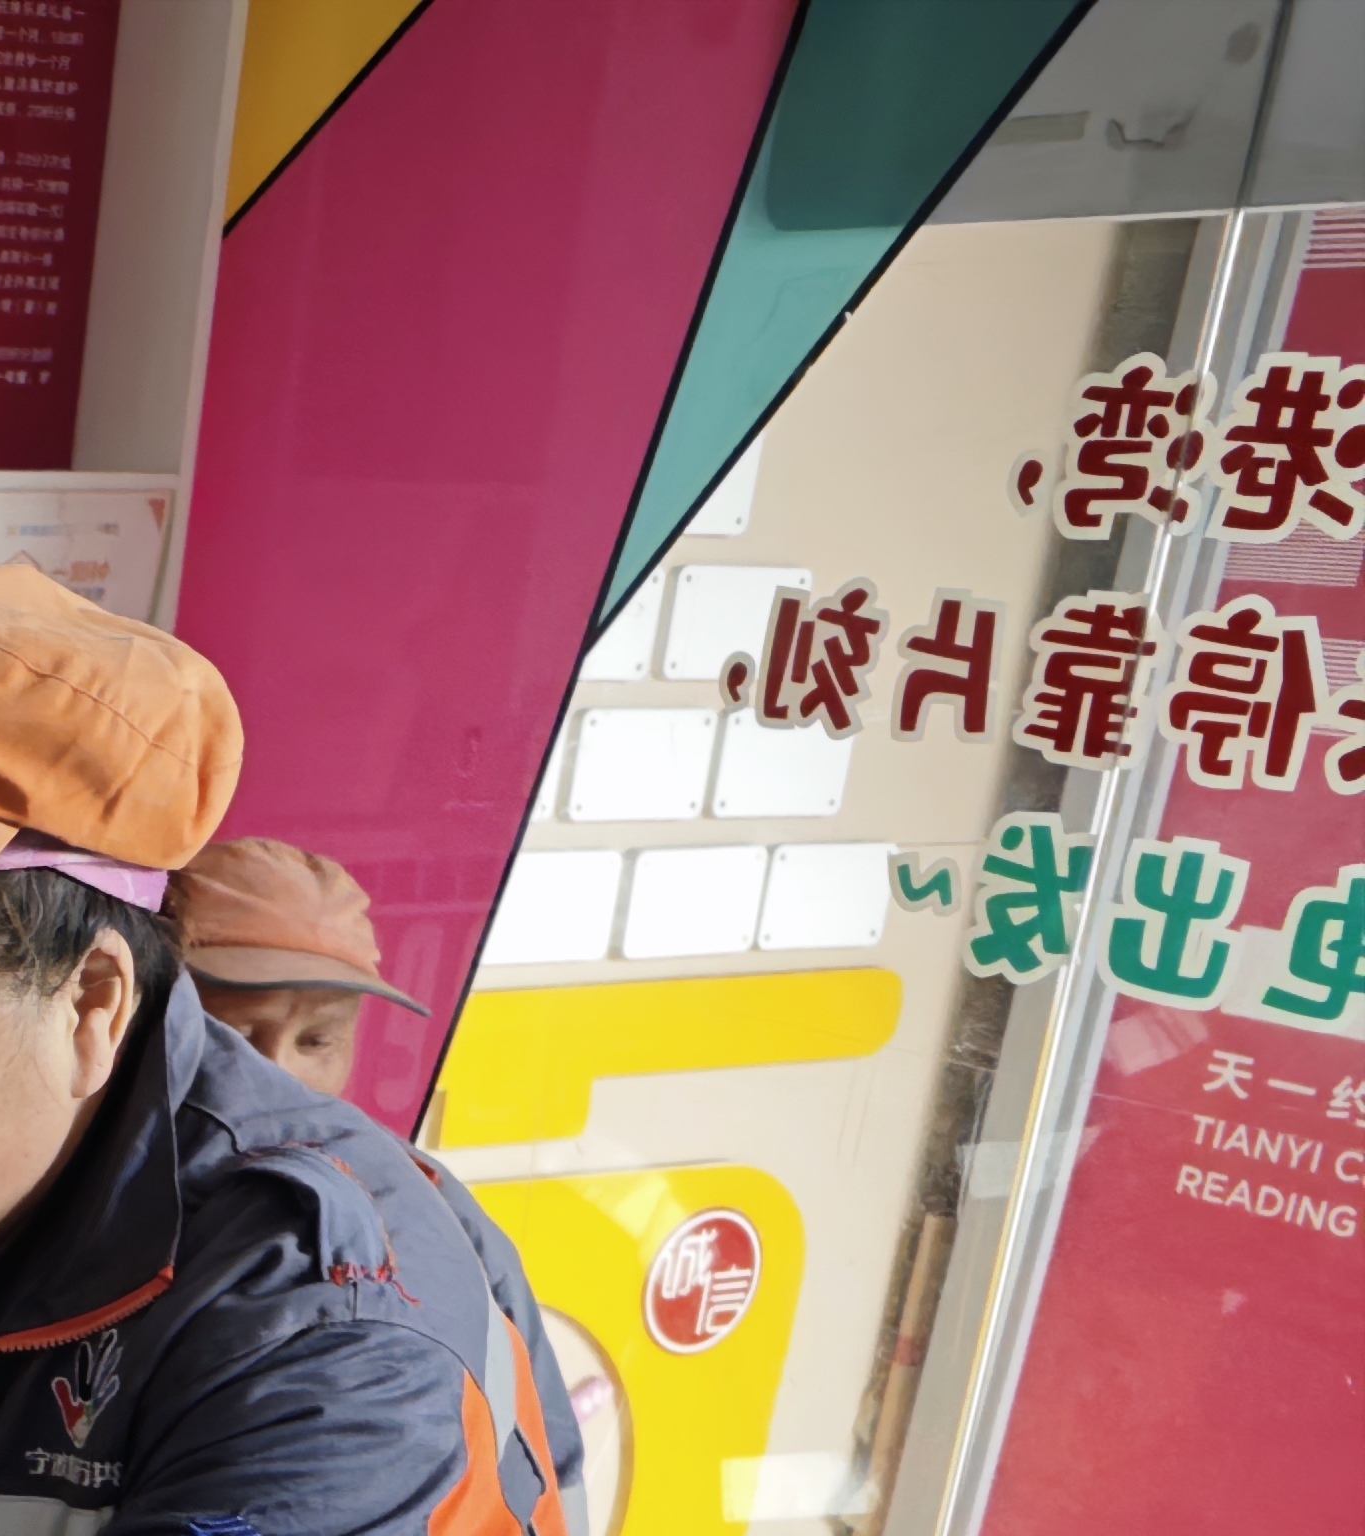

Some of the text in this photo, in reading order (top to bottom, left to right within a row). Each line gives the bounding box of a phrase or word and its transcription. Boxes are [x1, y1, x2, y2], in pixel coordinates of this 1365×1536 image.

[1192, 1113, 1324, 1174] TIANYI
[1175, 1164, 1358, 1237] READING
[659, 1228, 753, 1336] 诚信
